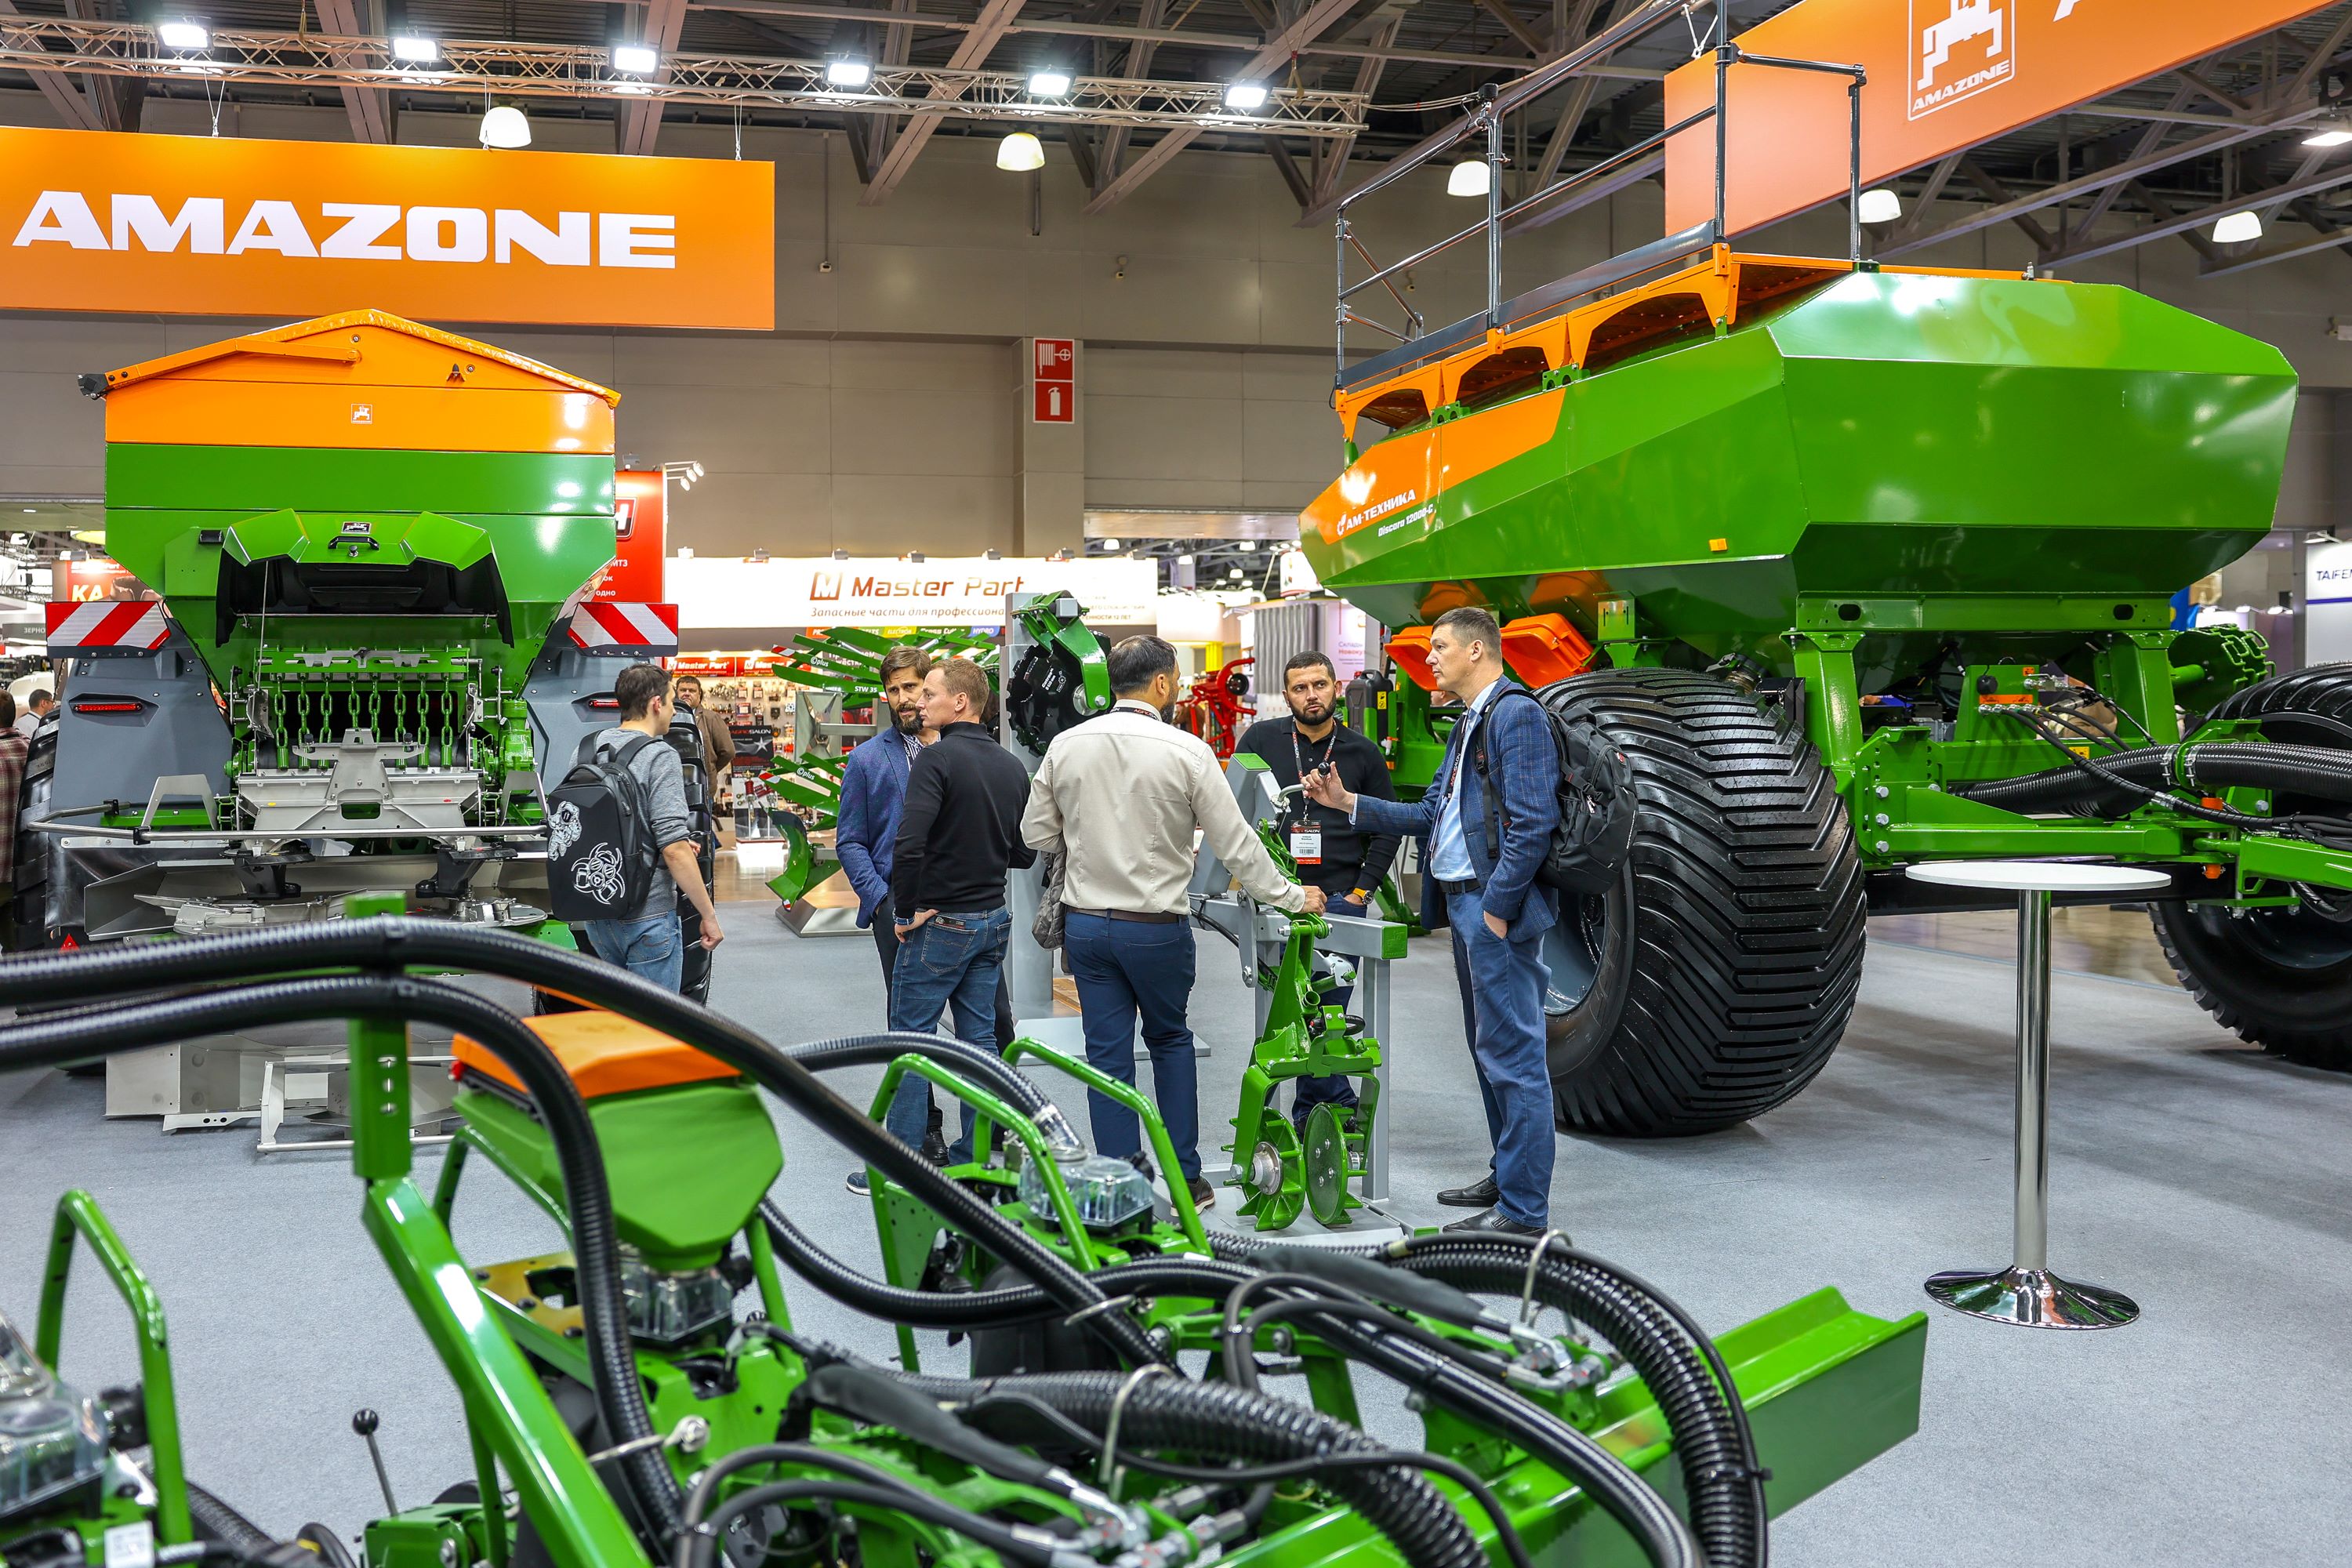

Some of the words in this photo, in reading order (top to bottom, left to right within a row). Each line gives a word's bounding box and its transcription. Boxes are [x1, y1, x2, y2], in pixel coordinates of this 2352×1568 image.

[1911, 59, 2010, 113] AMAZONE
[12, 190, 676, 269] AMAZONE
[1346, 489, 1416, 531] АМ-ТЕХНИКА
[1377, 518, 1405, 537] Discara
[2316, 569, 2352, 581] TAIFE
[851, 576, 954, 597] Master
[964, 576, 1025, 597] Part
[811, 607, 866, 617] Запасные
[909, 607, 927, 616] для
[678, 661, 708, 670] Master
[710, 661, 727, 670] Part
